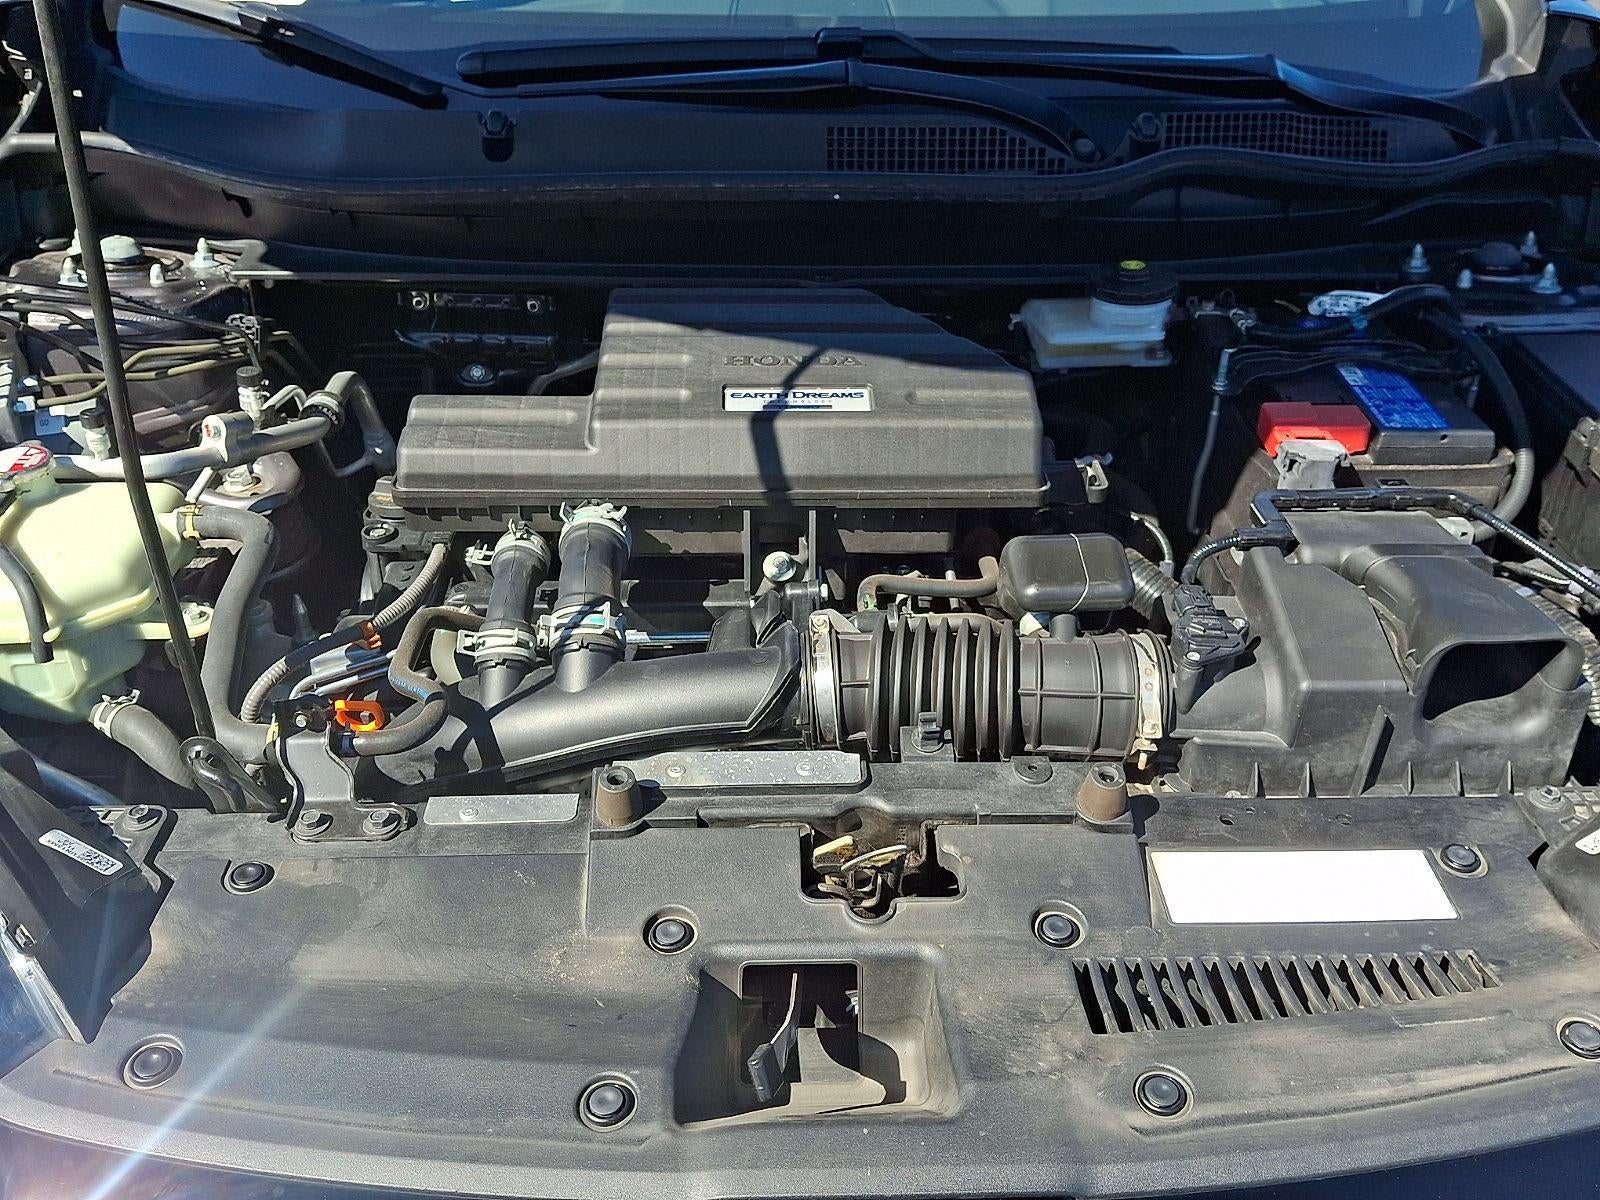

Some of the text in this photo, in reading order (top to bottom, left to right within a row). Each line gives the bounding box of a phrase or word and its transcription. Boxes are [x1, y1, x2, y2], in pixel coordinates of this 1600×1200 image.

[724, 355, 867, 367] HONDA
[730, 391, 864, 399] EARTH DREAMS
